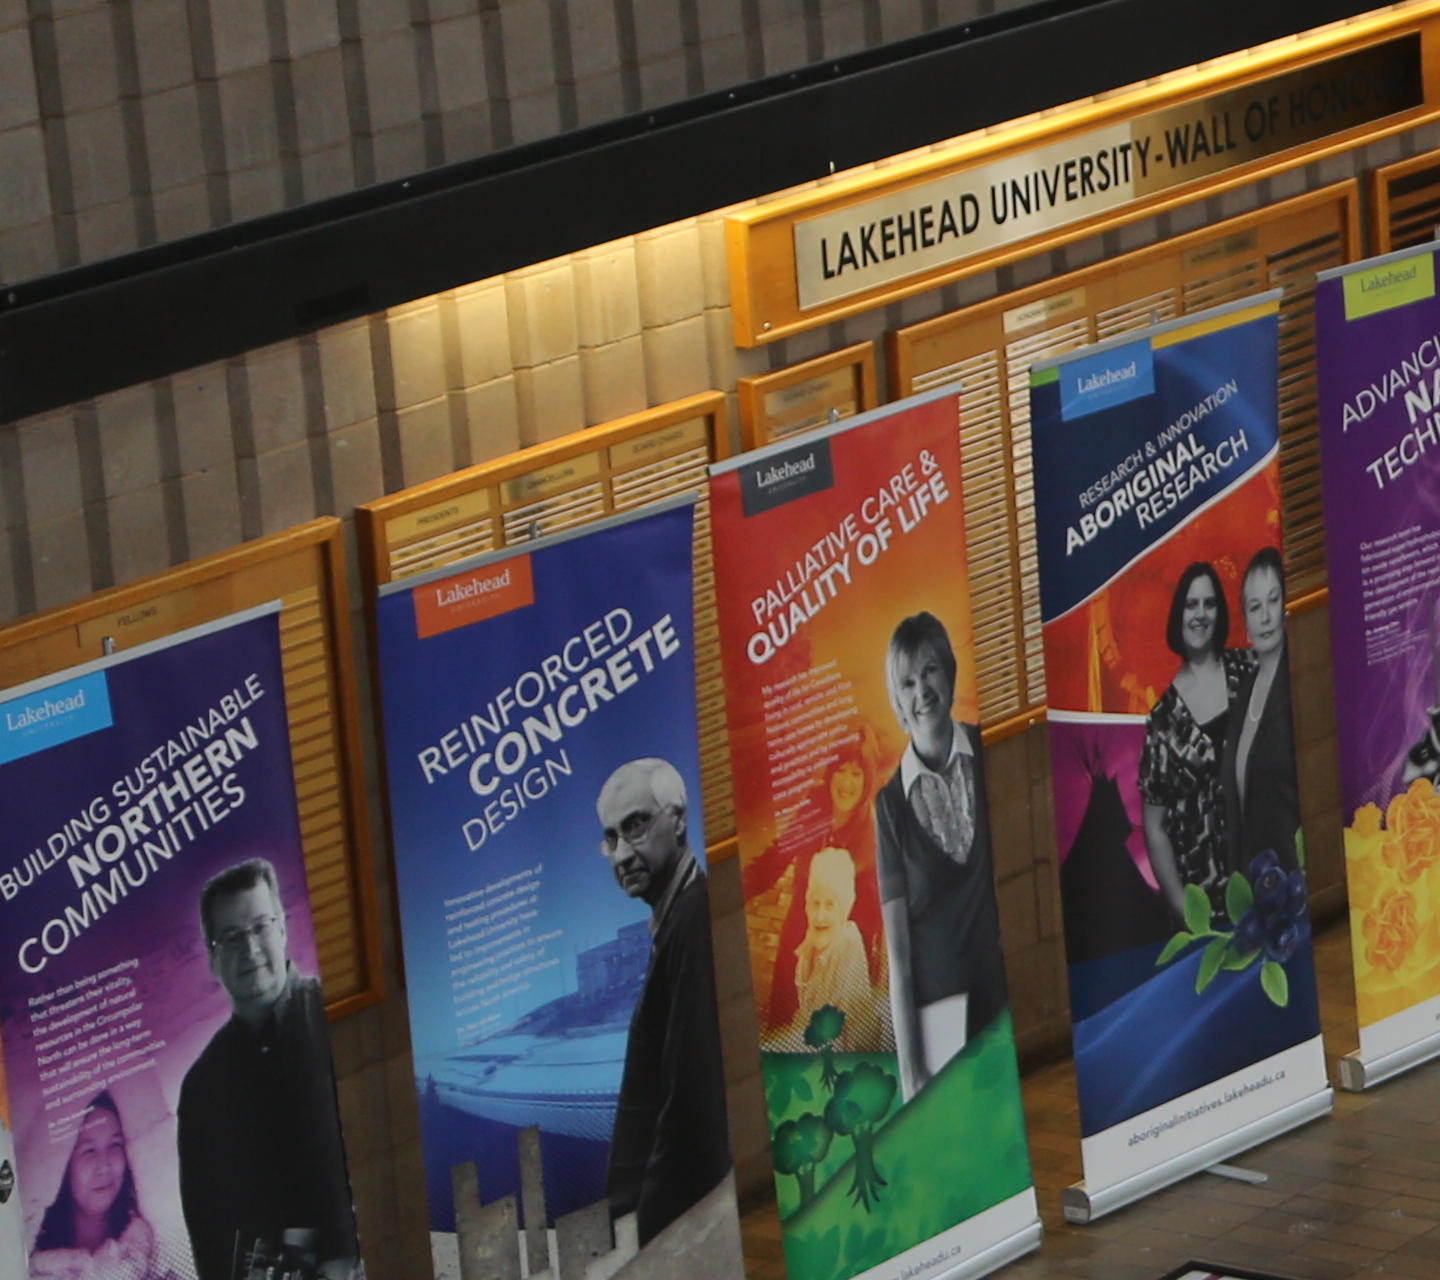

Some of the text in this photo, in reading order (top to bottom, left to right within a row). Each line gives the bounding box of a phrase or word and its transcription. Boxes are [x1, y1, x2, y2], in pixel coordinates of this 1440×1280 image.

[820, 193, 980, 280] LAKEHEAD
[1245, 96, 1279, 143] OF
[1361, 266, 1417, 292] Lakehead
[1076, 362, 1136, 393] Lakehead
[756, 453, 815, 488] Lakehead
[1066, 433, 1206, 556] ABORIGINAL
[1079, 379, 1238, 508] RESEARCH & INNOVATION
[1135, 429, 1249, 530] RESEARCH
[436, 569, 510, 608] Lakehead
[747, 472, 950, 665] QUALITY OF LIFE
[751, 449, 938, 624] PALLIATIVE CARE &
[6, 689, 86, 732] Lakehead
[418, 608, 632, 784] REINFORCED
[469, 614, 680, 796] CONCRETE
[0, 673, 266, 901] BUILDING SUSTAINABLE
[67, 717, 259, 888] NORTHERN
[462, 750, 572, 851] DESIGN
[18, 773, 246, 973] COMMUNITIES
